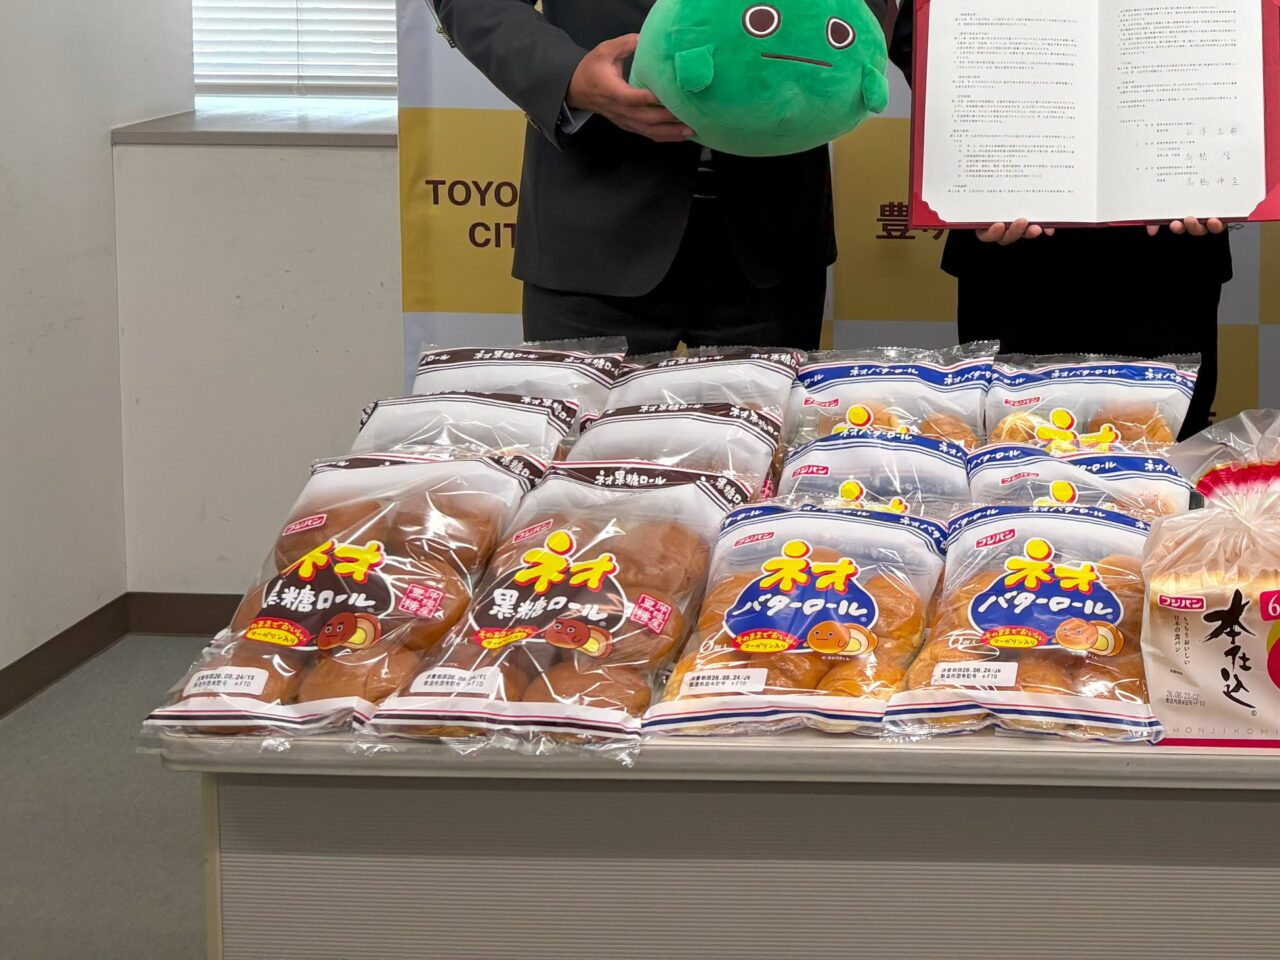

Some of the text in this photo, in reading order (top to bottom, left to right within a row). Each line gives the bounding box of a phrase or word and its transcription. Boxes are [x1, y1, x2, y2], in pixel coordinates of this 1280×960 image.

[976, 529, 1015, 548] フジパン
[513, 531, 617, 594] ネオ
[758, 540, 859, 594] ネオ
[1004, 539, 1100, 594] ネオ
[488, 588, 609, 621] 黒糖ロール
[731, 593, 868, 617] バターロール
[977, 593, 1114, 617] バターロール
[1161, 596, 1204, 609] フジパン
[1269, 595, 1280, 617] 6
[1173, 614, 1182, 654] 日本の食パン
[1202, 589, 1256, 709] 本仕込
